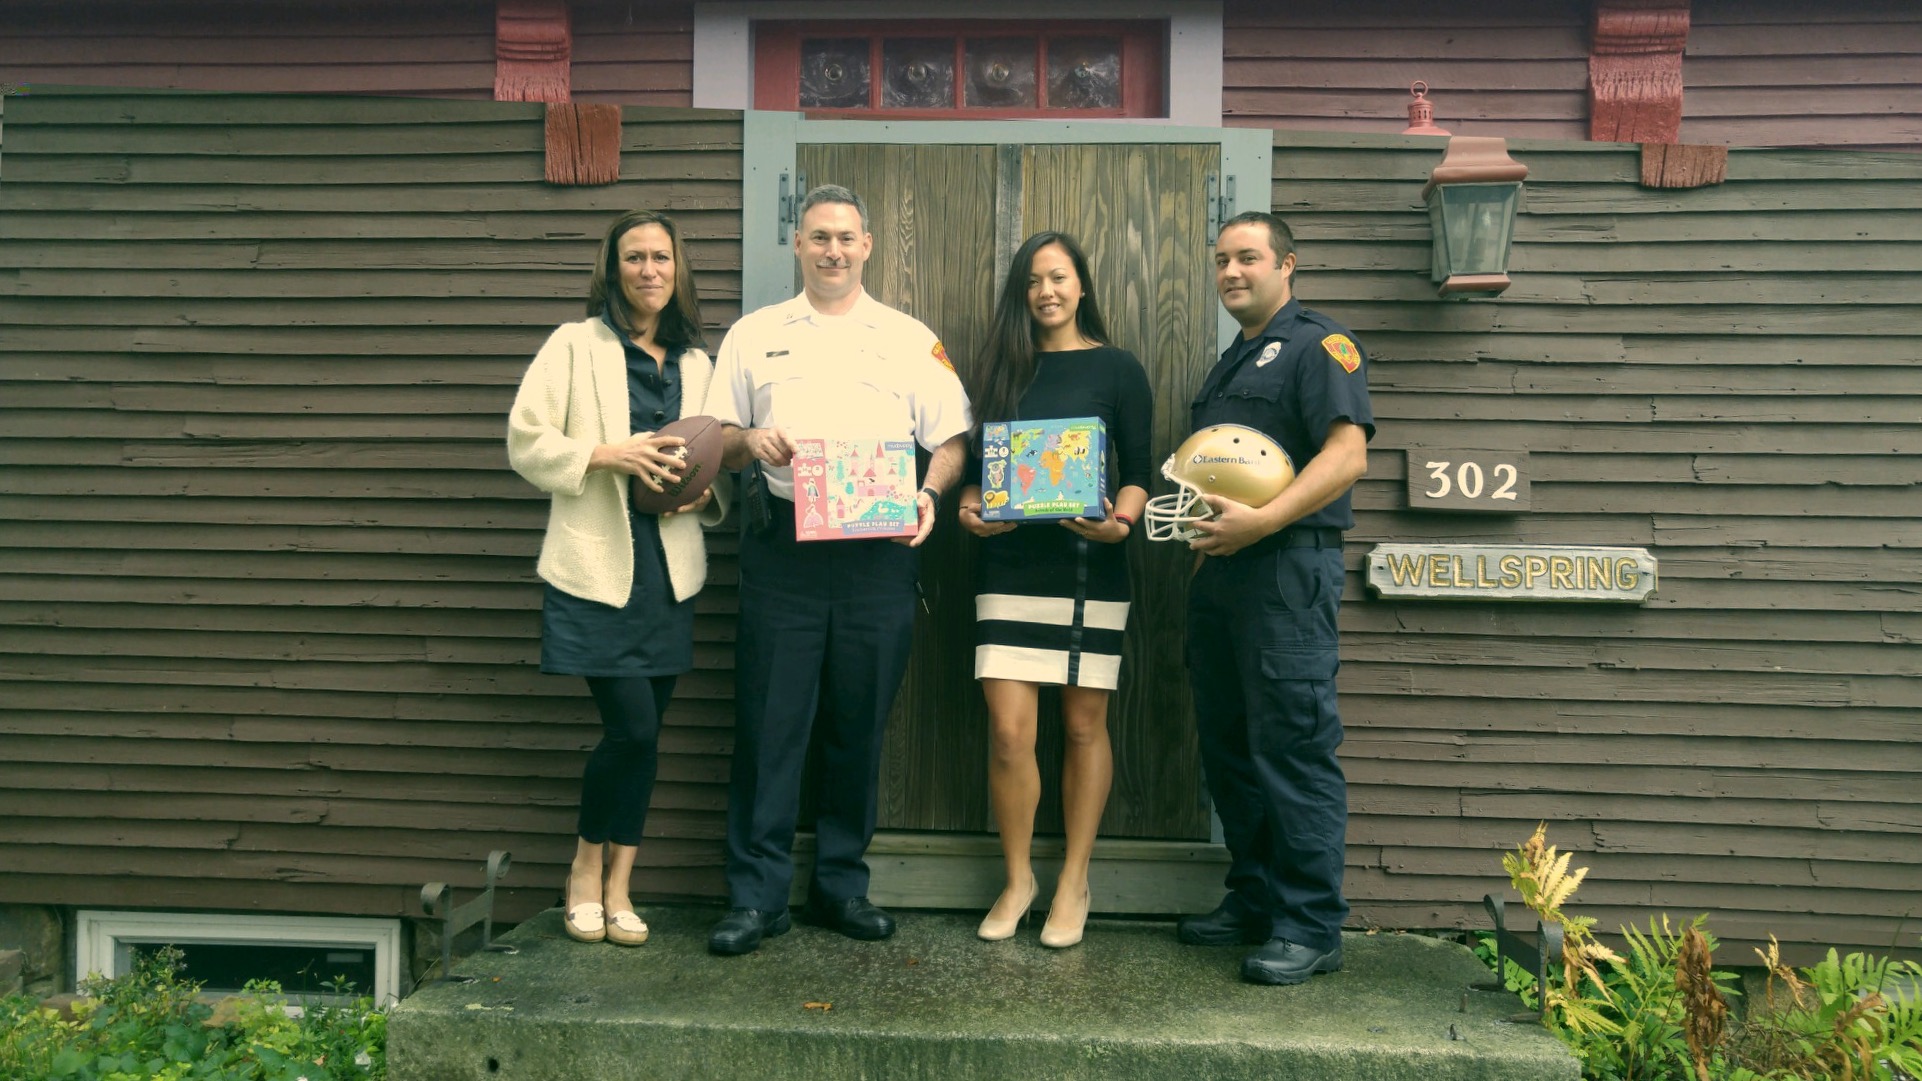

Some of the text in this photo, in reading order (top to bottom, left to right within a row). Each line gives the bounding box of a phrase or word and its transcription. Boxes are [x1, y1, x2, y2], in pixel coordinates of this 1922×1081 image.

[1203, 455, 1237, 464] Eastern
[669, 463, 702, 497] Wilson
[1425, 461, 1518, 501] 302
[1386, 553, 1640, 592] WELLSPRING
